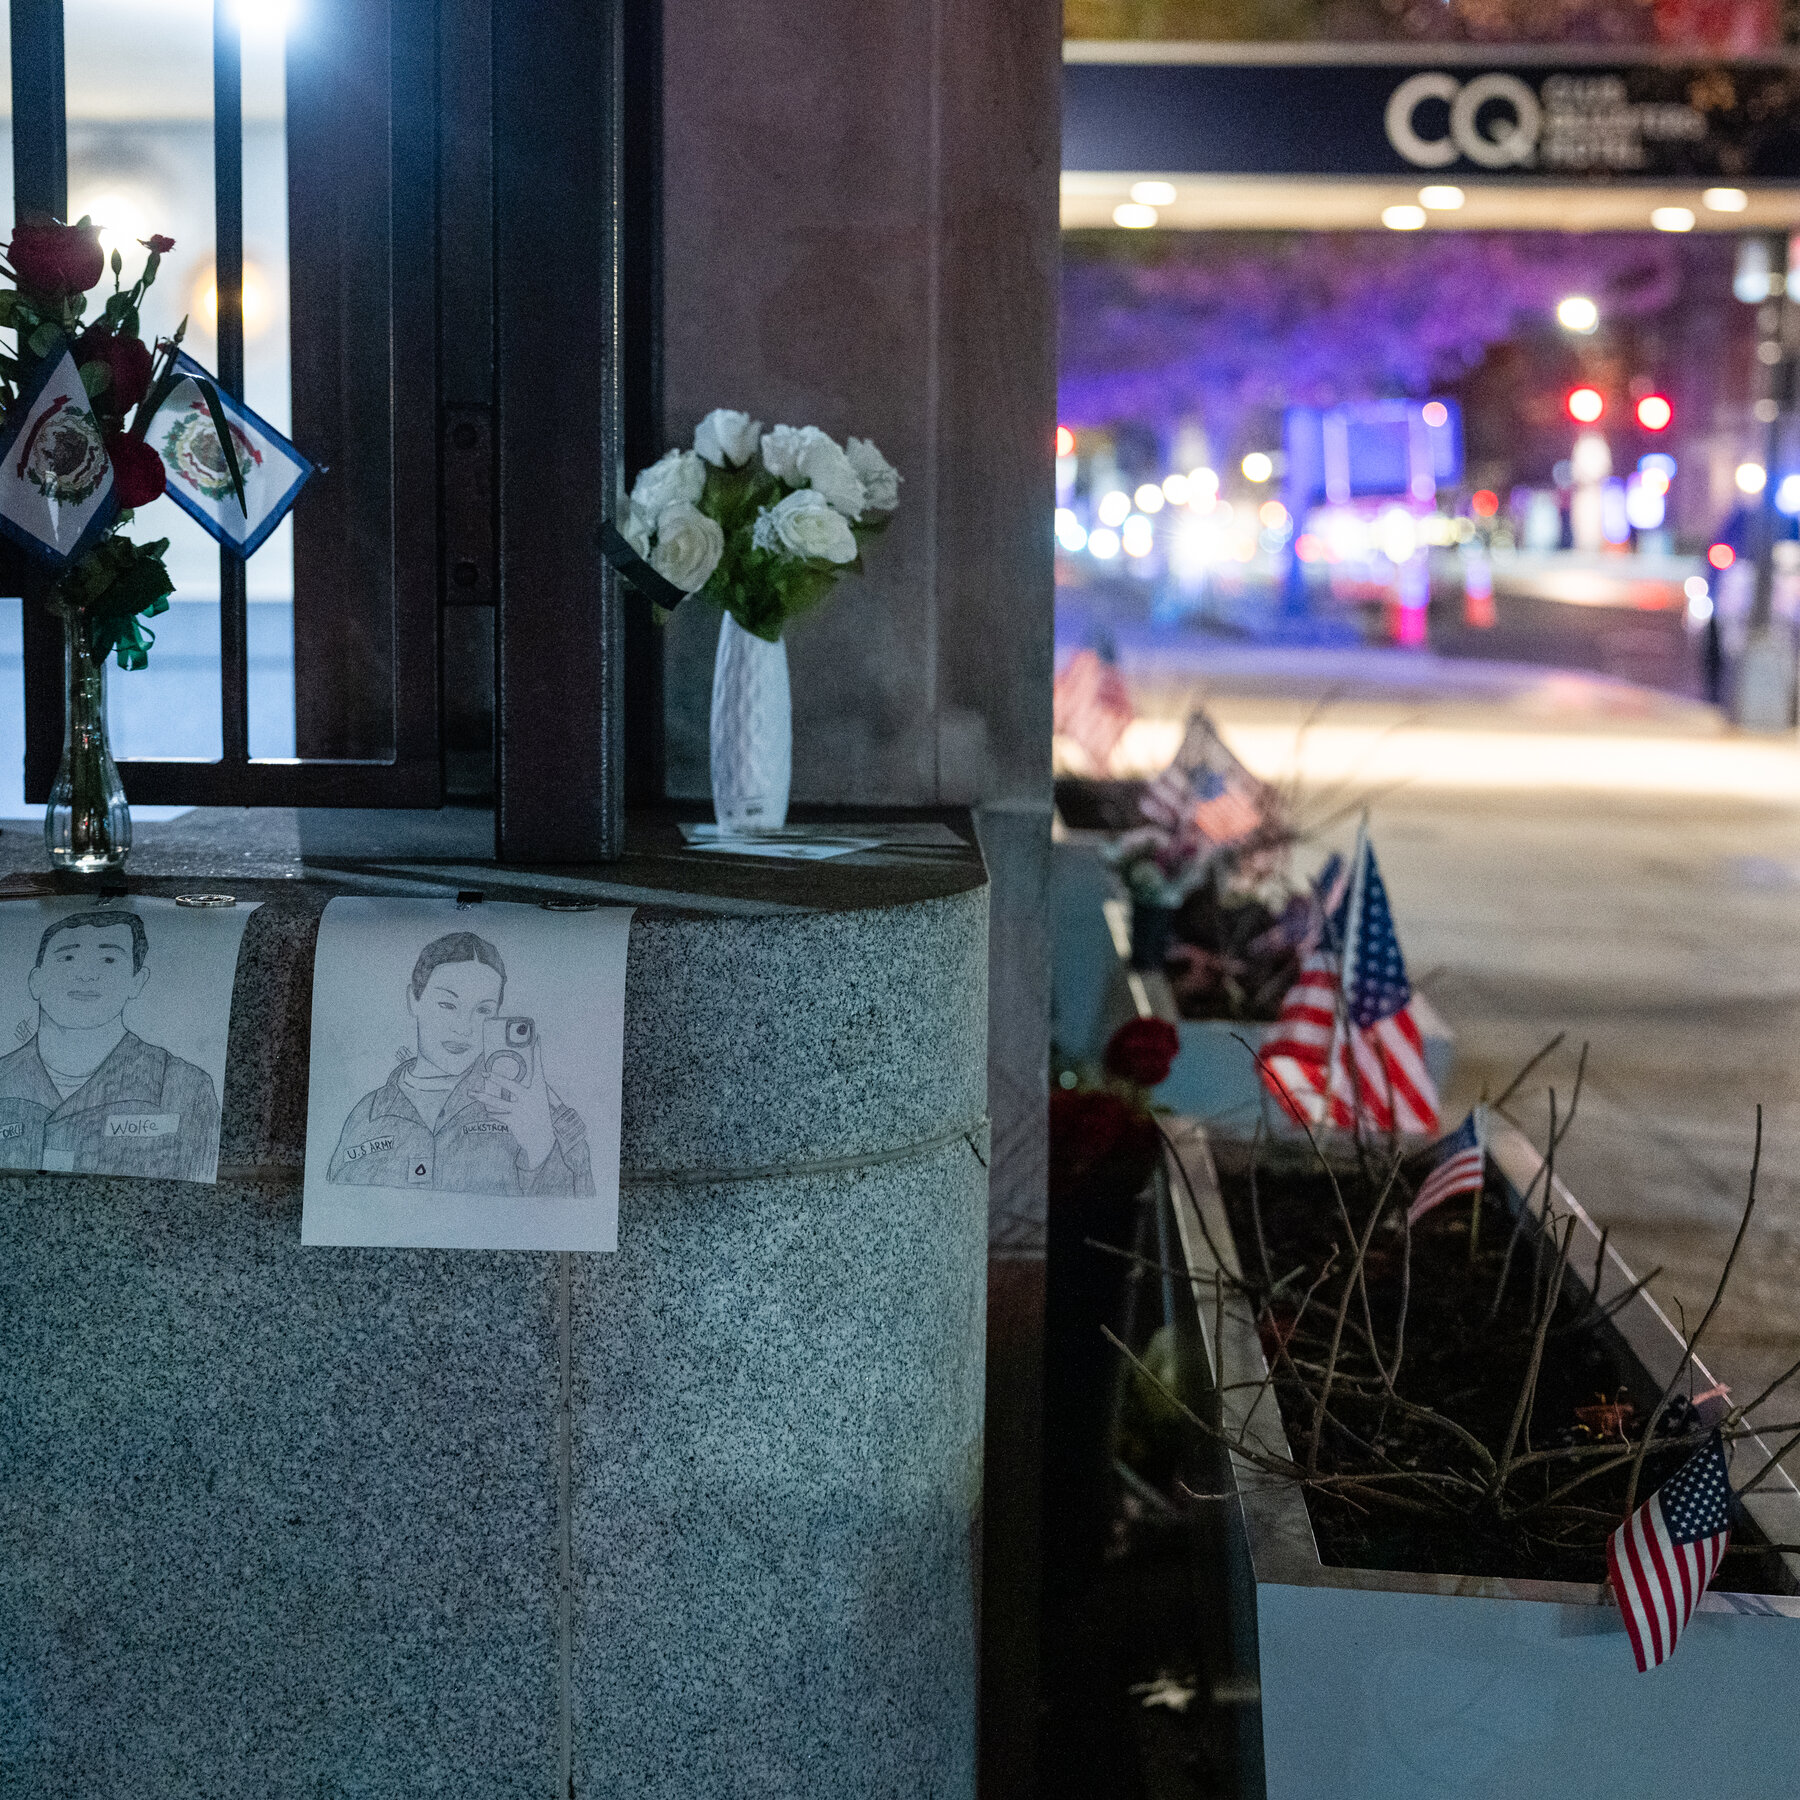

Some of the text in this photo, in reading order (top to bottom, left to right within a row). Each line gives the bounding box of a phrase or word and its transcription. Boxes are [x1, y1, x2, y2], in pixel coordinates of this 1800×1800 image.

[1385, 72, 1541, 167] CQ
[110, 1119, 159, 1135] Wolfe
[370, 1140, 393, 1154] ARMY
